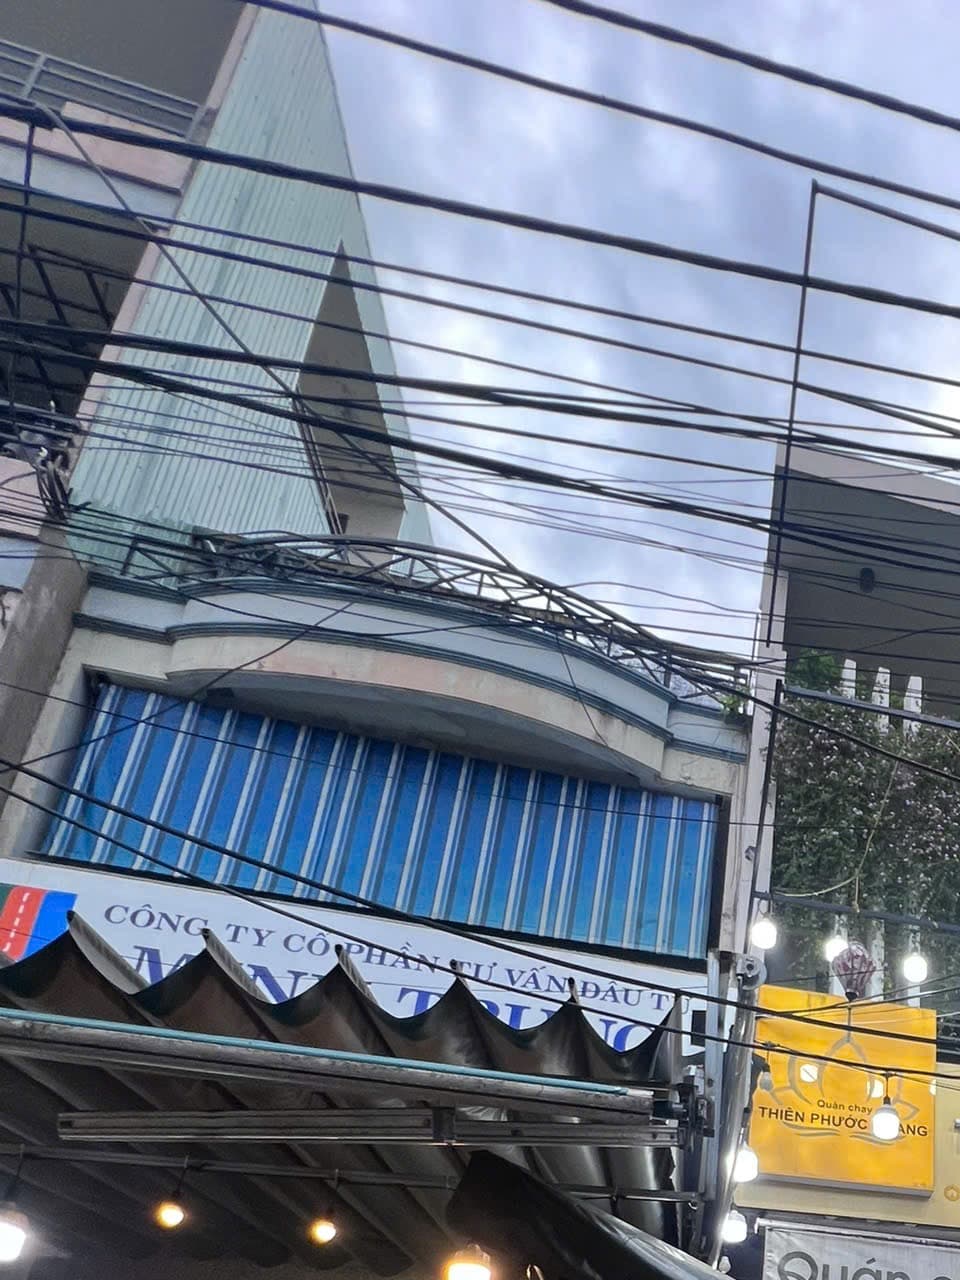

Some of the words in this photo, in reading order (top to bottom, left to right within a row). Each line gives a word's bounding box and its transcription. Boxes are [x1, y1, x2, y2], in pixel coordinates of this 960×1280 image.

[104, 903, 209, 937] CÔNG
[226, 922, 275, 947] TY
[505, 966, 567, 993] VẤN
[758, 1106, 805, 1123] THIÊN
[810, 1112, 868, 1130] PHƯỚC
[848, 1104, 873, 1115] chay
